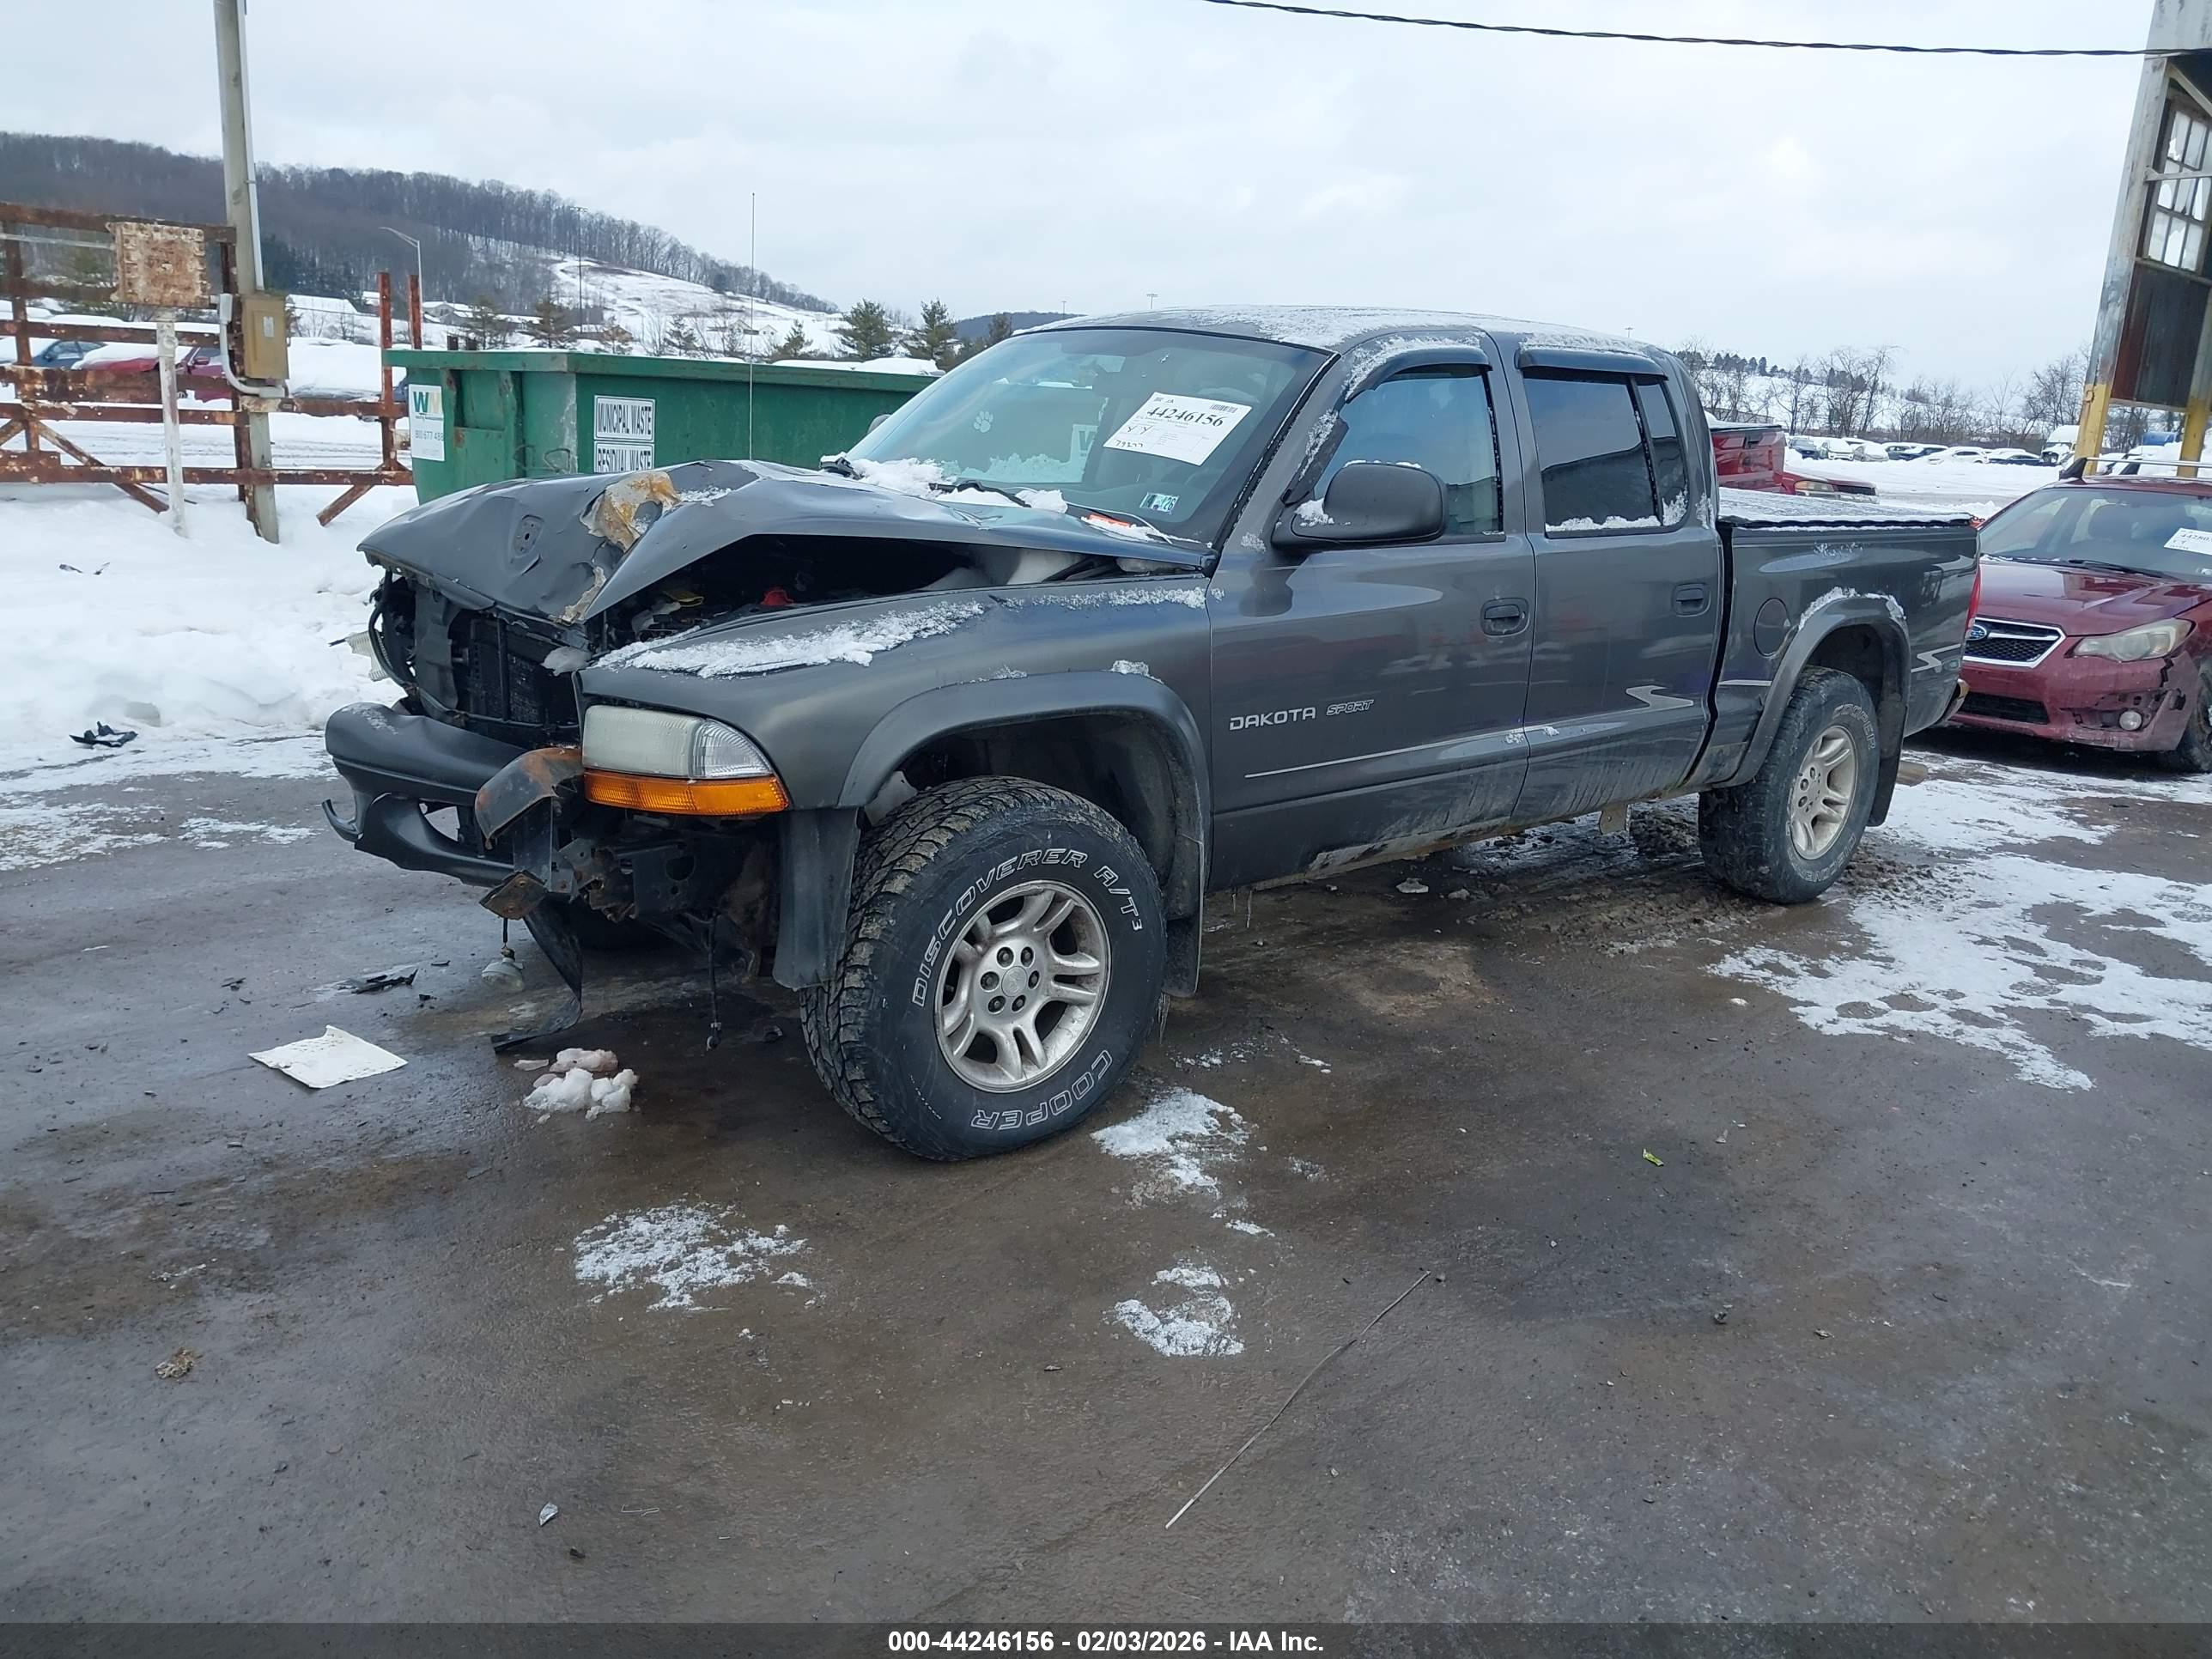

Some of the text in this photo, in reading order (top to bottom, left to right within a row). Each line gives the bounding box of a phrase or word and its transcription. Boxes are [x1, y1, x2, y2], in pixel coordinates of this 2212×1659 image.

[598, 403, 652, 434] MUNICIPAL WASTE
[1146, 406, 1227, 428] 44246156
[598, 448, 651, 472] RESIDUAL WASTE
[1229, 699, 1374, 731] DAKOTA SPORT
[913, 848, 1088, 1008] DISCOVERER
[970, 1048, 1113, 1131] COOPER
